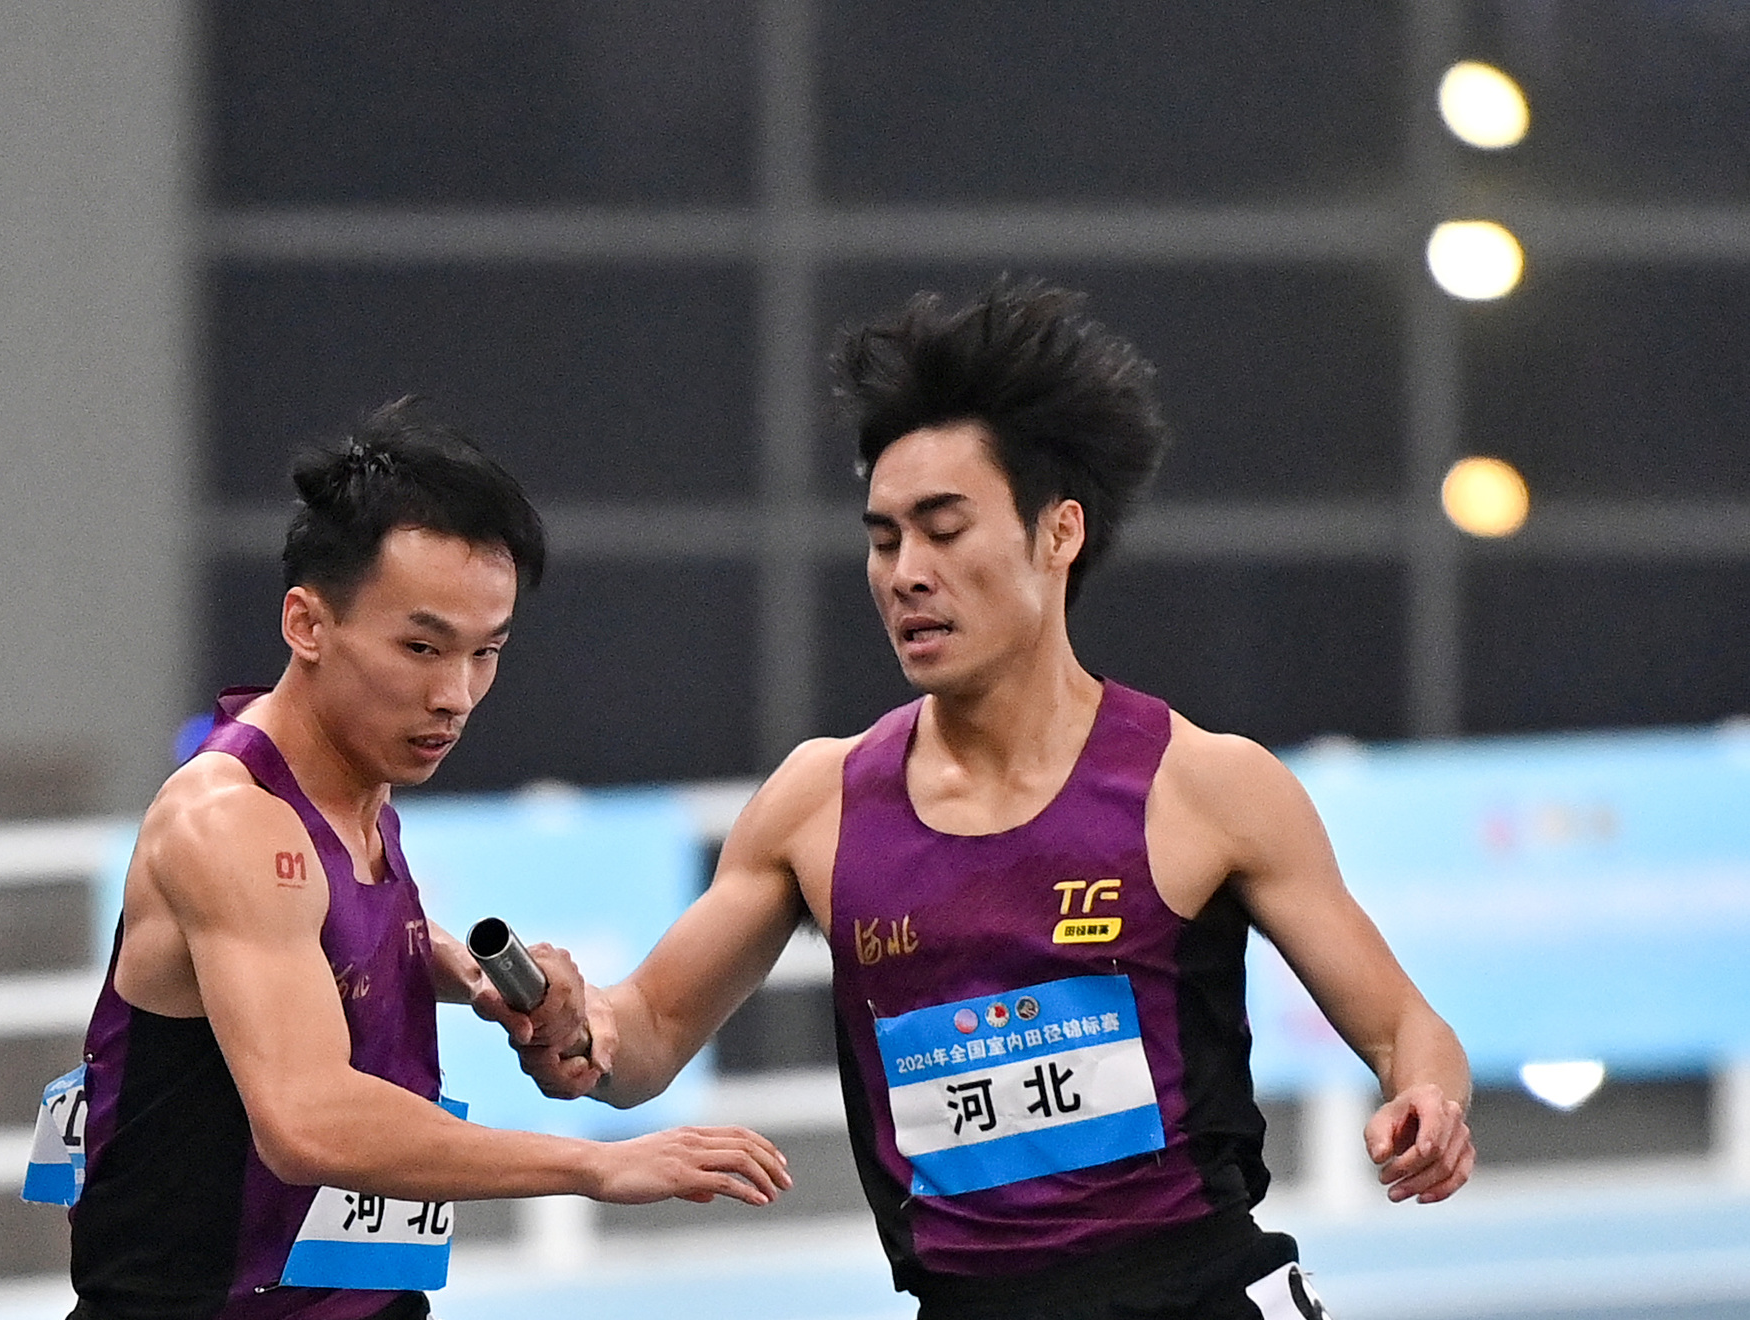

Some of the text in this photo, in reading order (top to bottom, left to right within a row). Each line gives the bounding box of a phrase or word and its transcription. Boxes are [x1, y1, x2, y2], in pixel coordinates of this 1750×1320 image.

[275, 852, 307, 880] 01
[1053, 879, 1122, 915] TF
[896, 1012, 1120, 1074] 2024年全国室内田径锦标赛
[946, 1062, 1081, 1135] 河北
